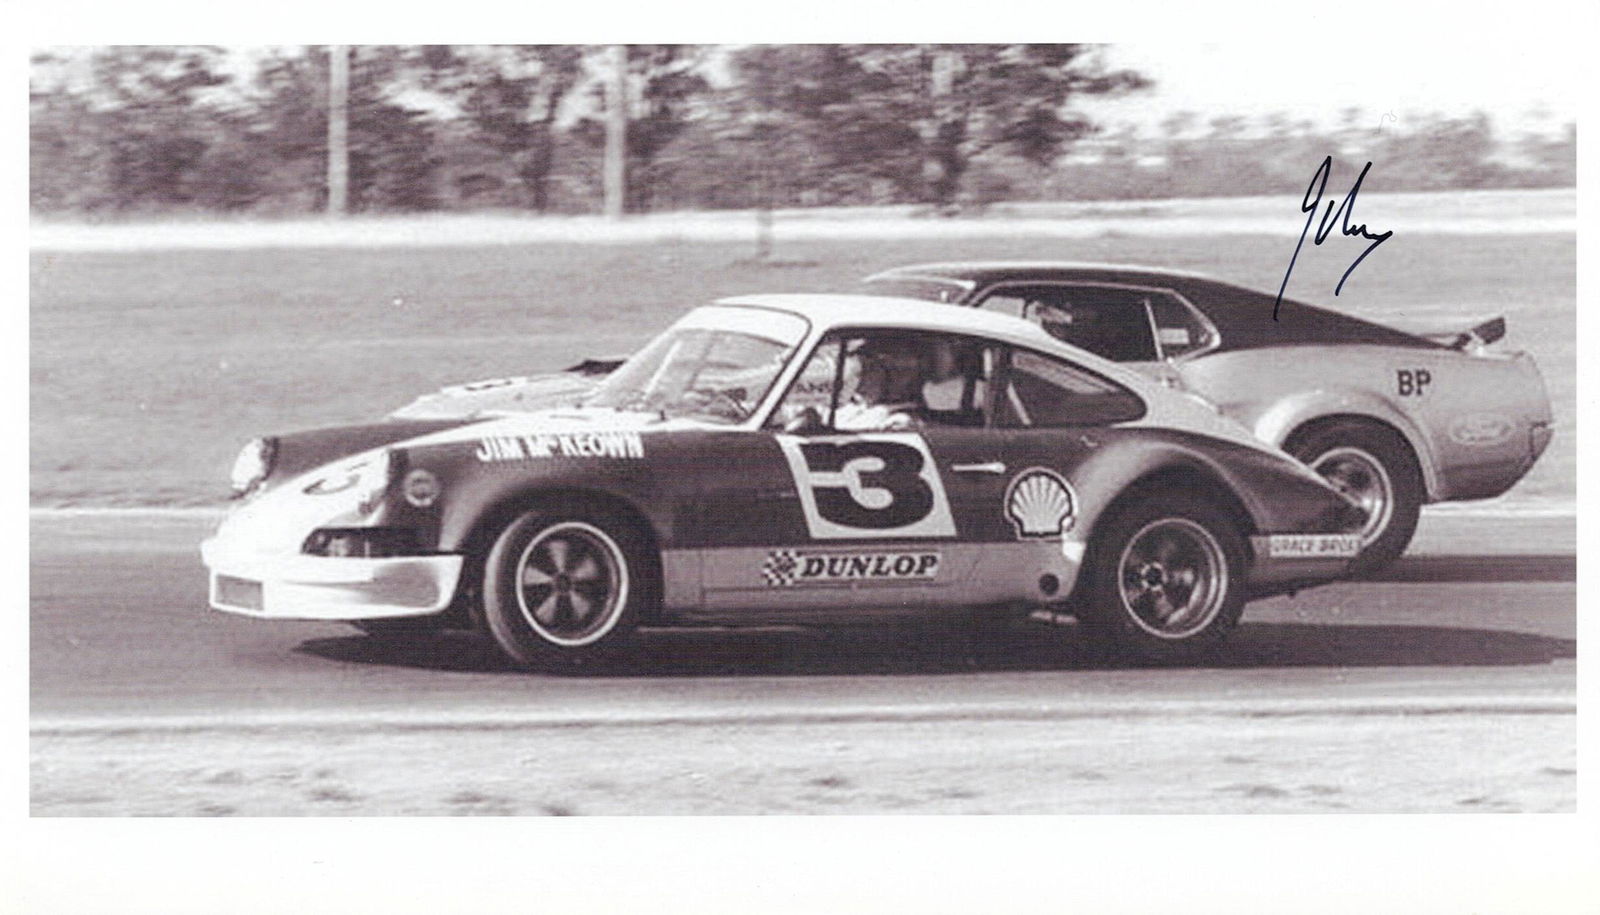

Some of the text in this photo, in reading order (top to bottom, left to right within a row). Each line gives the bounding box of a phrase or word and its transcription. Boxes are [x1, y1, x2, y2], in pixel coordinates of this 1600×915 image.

[1397, 369, 1431, 396] BP
[476, 436, 524, 462] JIM
[799, 441, 935, 529] 3
[800, 553, 937, 578] DUNLOP
